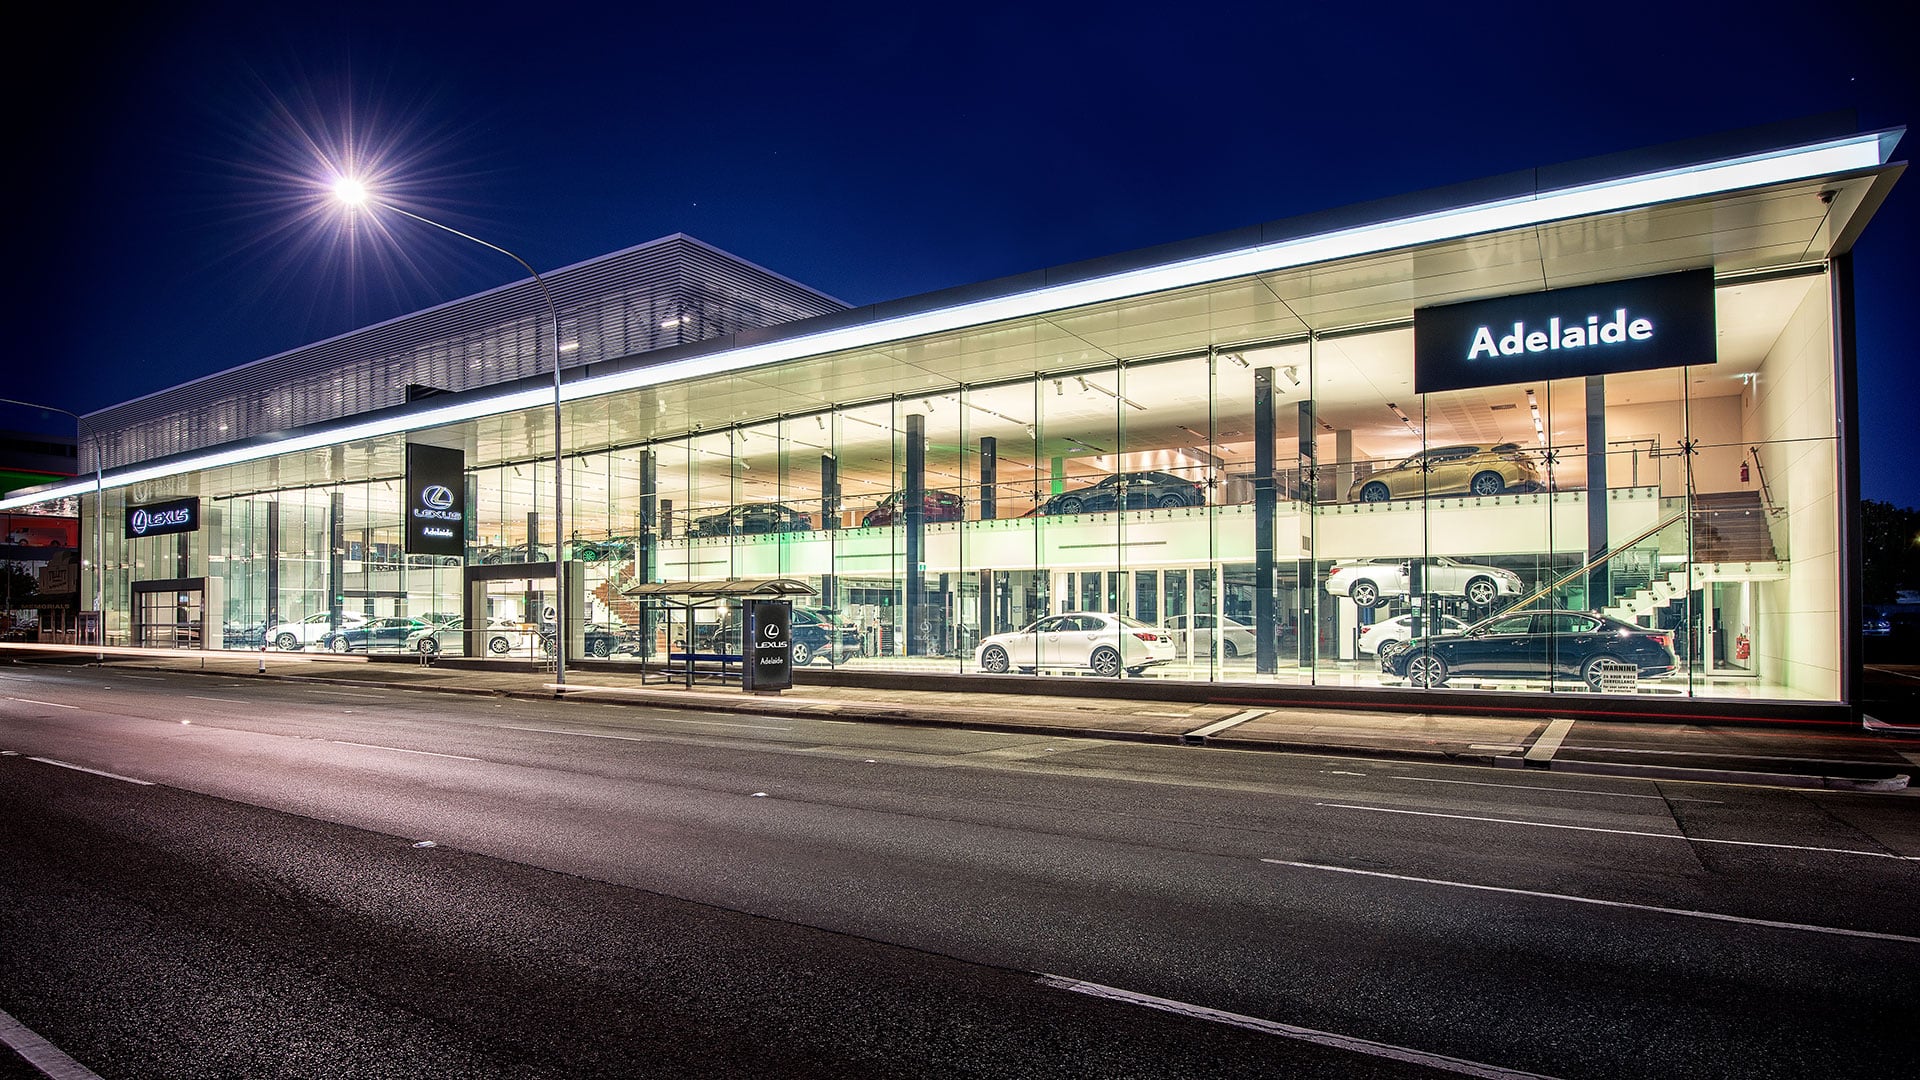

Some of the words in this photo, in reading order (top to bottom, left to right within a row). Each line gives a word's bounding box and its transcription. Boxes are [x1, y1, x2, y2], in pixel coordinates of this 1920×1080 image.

[1467, 308, 1653, 360] Adelaide
[148, 508, 188, 527] LEXUS
[414, 508, 462, 521] LEXUS
[423, 527, 453, 537] Adelaide
[755, 641, 788, 649] LEXUS
[760, 656, 784, 665] Adelaide
